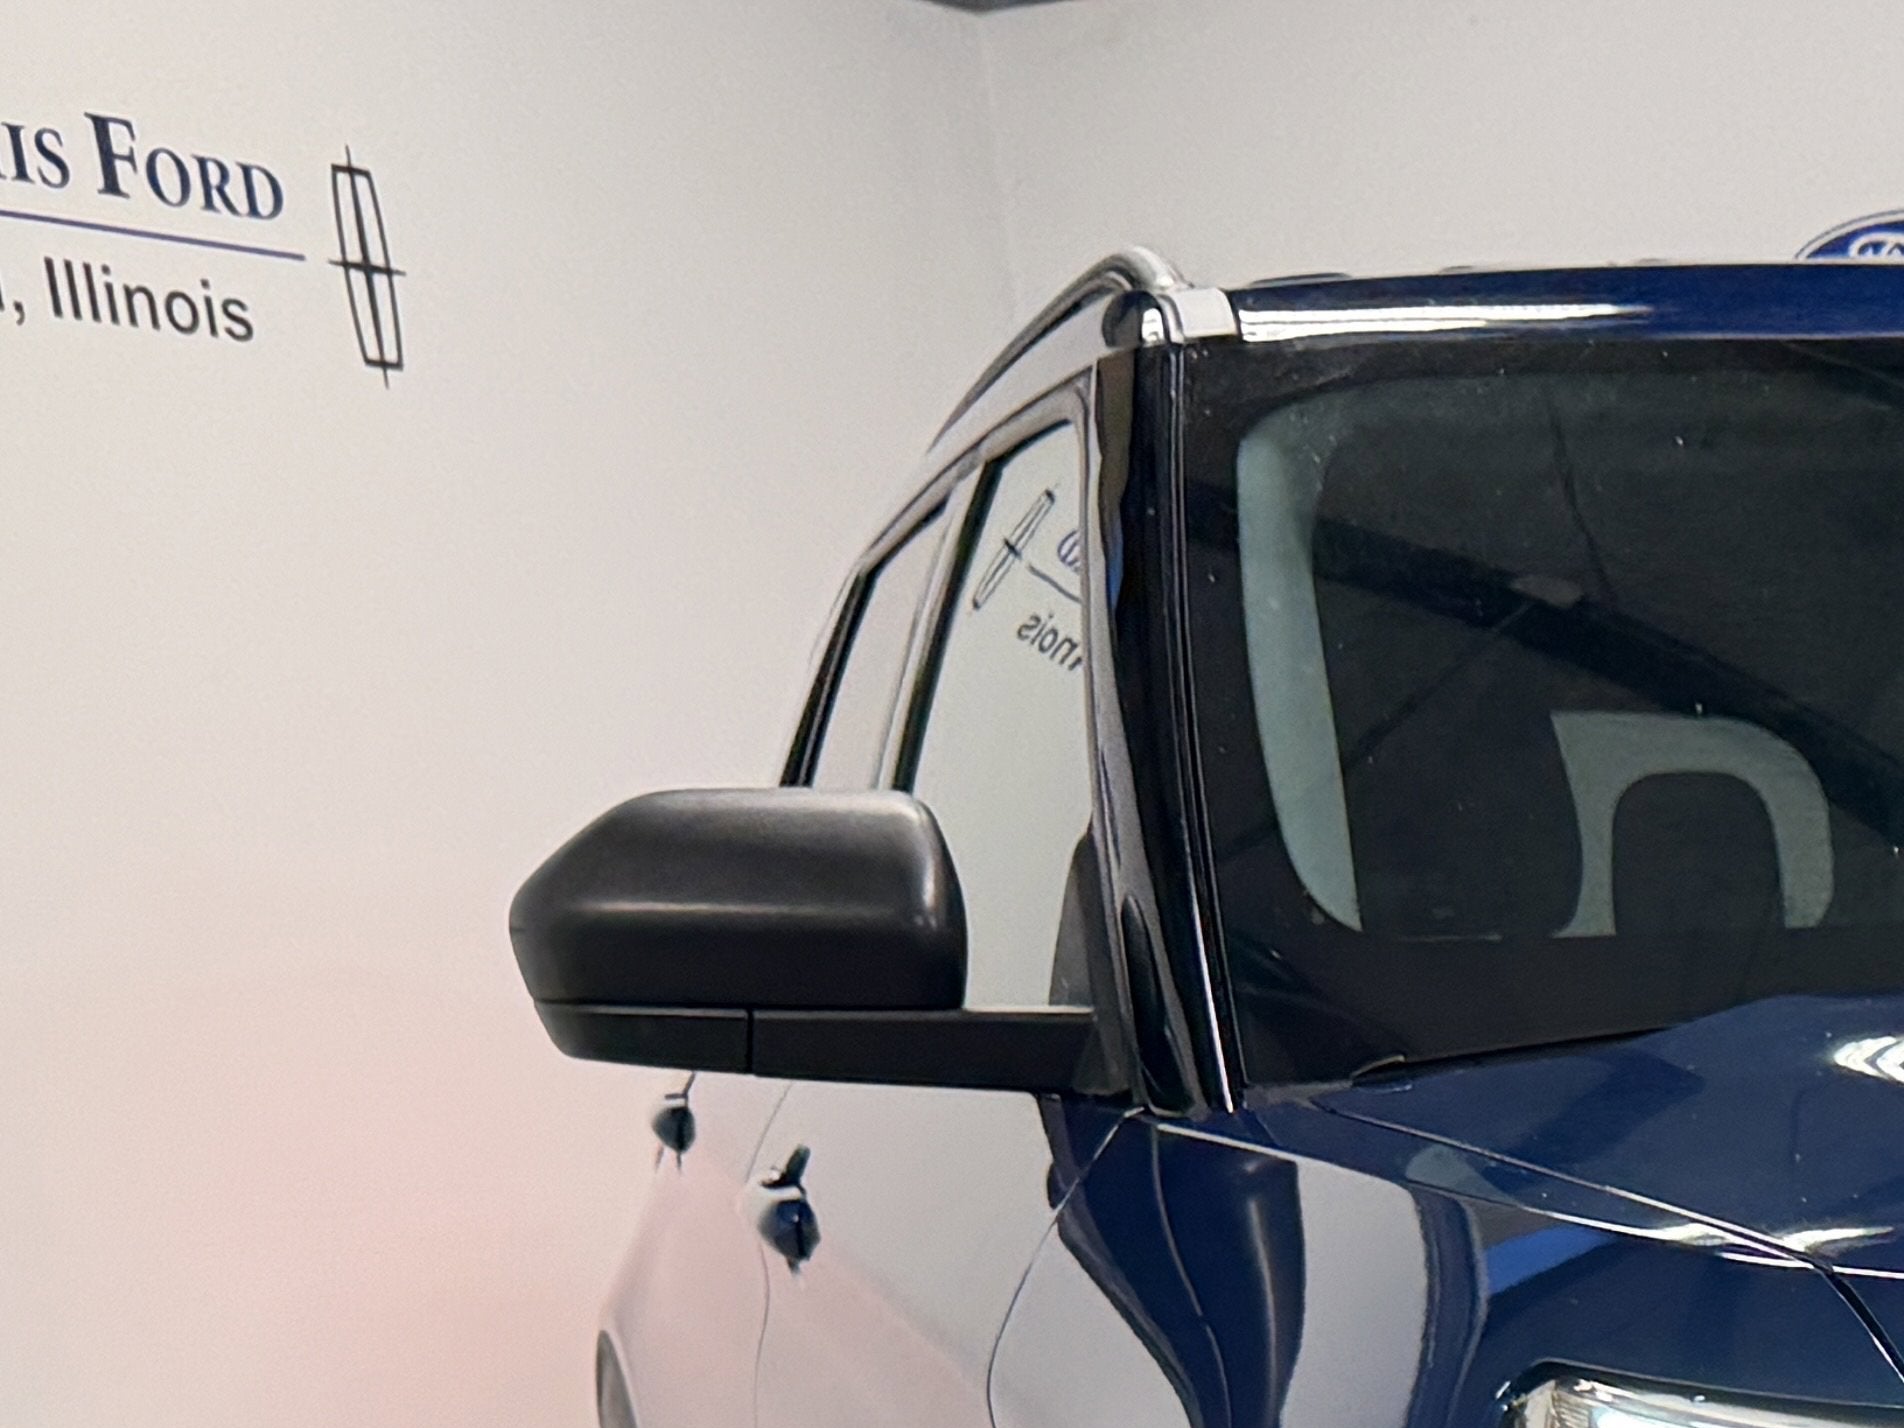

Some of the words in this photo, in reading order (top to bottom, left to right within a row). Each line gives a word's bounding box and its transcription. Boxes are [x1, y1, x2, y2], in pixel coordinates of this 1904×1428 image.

[0, 121, 70, 189] IS
[84, 111, 284, 220] FORD
[44, 256, 254, 342] Illinois
